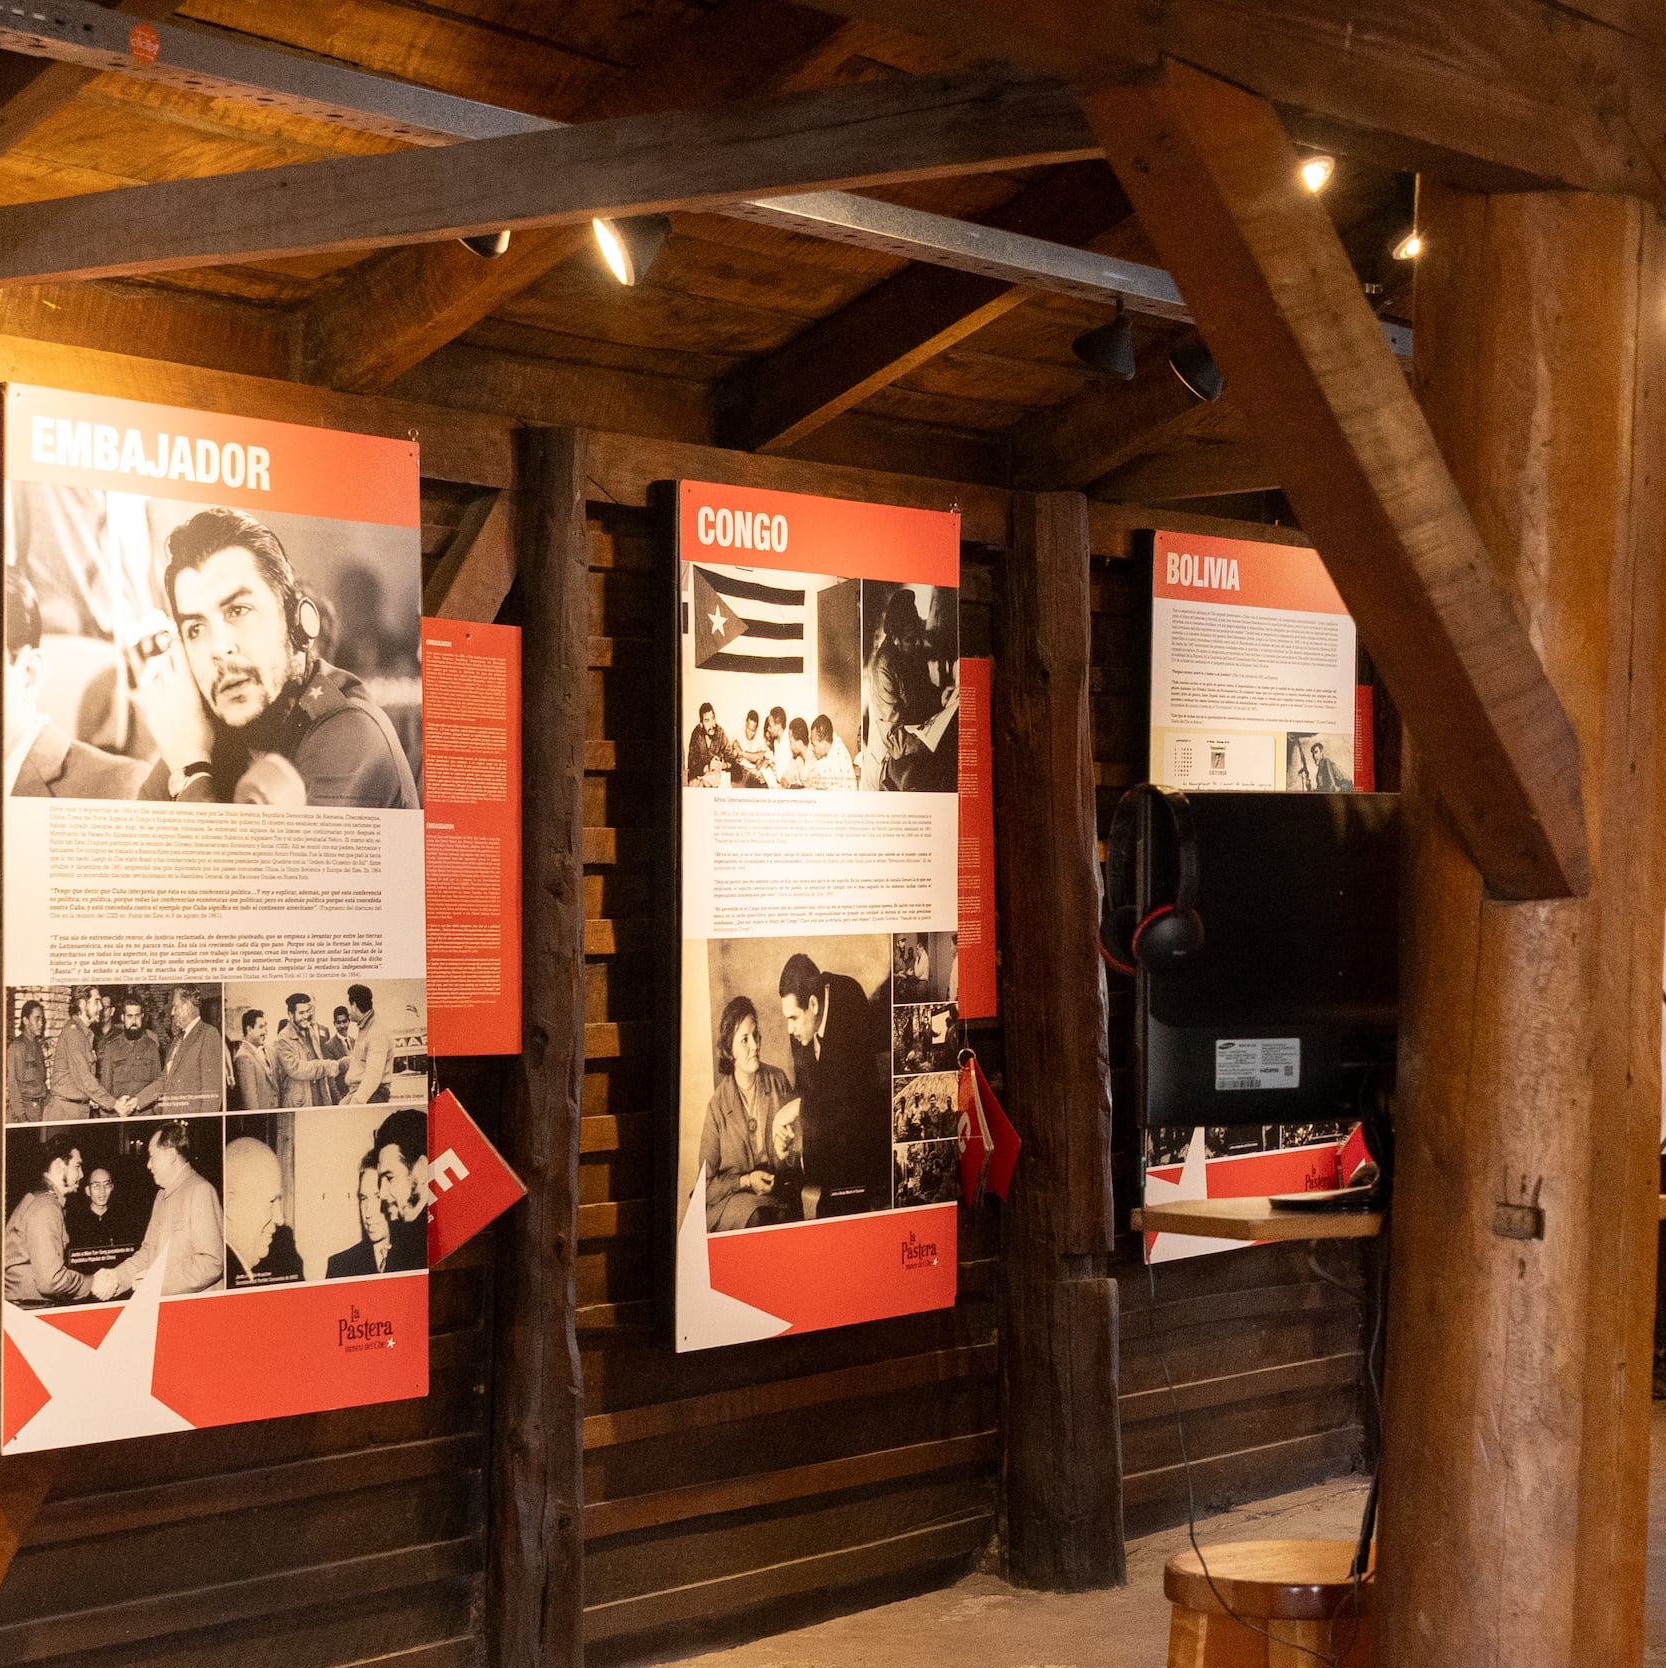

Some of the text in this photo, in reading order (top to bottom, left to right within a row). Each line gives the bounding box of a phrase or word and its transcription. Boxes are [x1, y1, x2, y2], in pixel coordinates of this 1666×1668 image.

[30, 414, 271, 491] EMBAJADOR
[697, 505, 789, 553] CONGO
[1166, 550, 1241, 592] BOLIVIA
[901, 1242, 937, 1264] Pastera
[338, 1318, 393, 1347] Pastera
